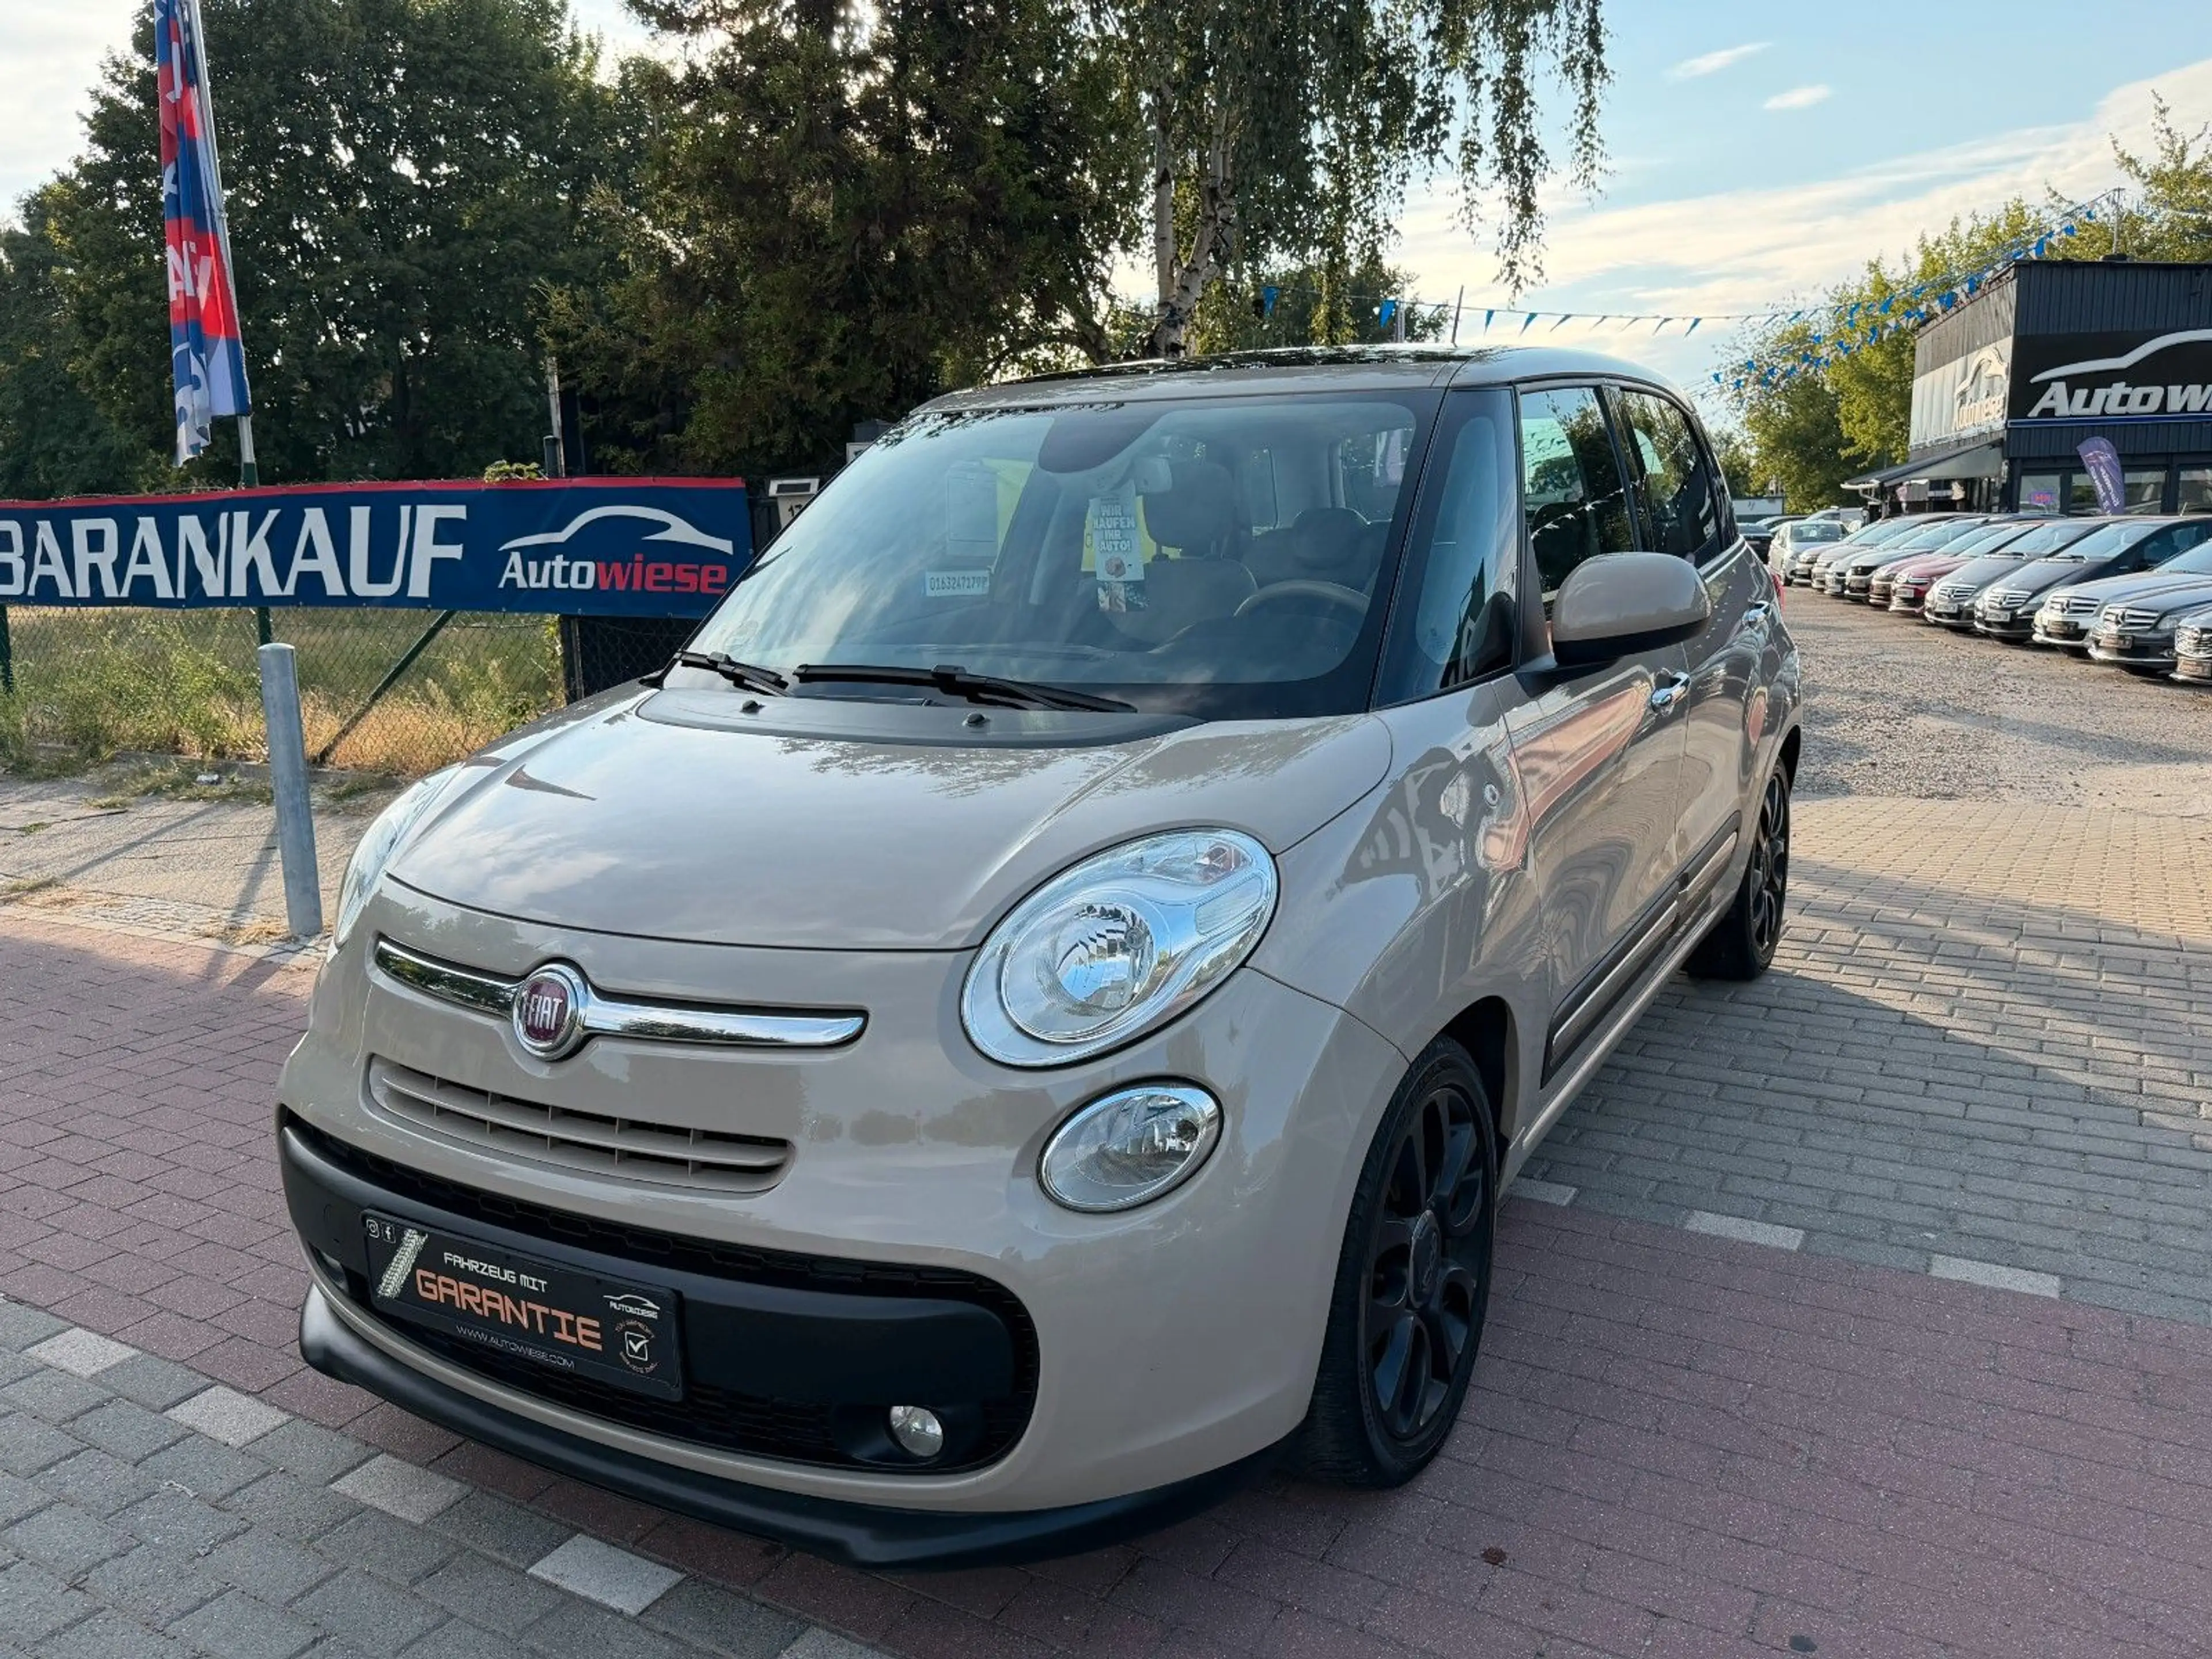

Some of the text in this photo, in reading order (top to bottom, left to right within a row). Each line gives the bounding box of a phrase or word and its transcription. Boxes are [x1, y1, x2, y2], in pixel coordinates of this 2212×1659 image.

[2028, 381, 2212, 418] Autow
[1100, 503, 1123, 517] WIR
[498, 551, 728, 594] Autowiese
[527, 994, 564, 1031] FIAT
[443, 1251, 548, 1293] FAHRZEUG MIT
[415, 1268, 603, 1352] GARANTIE
